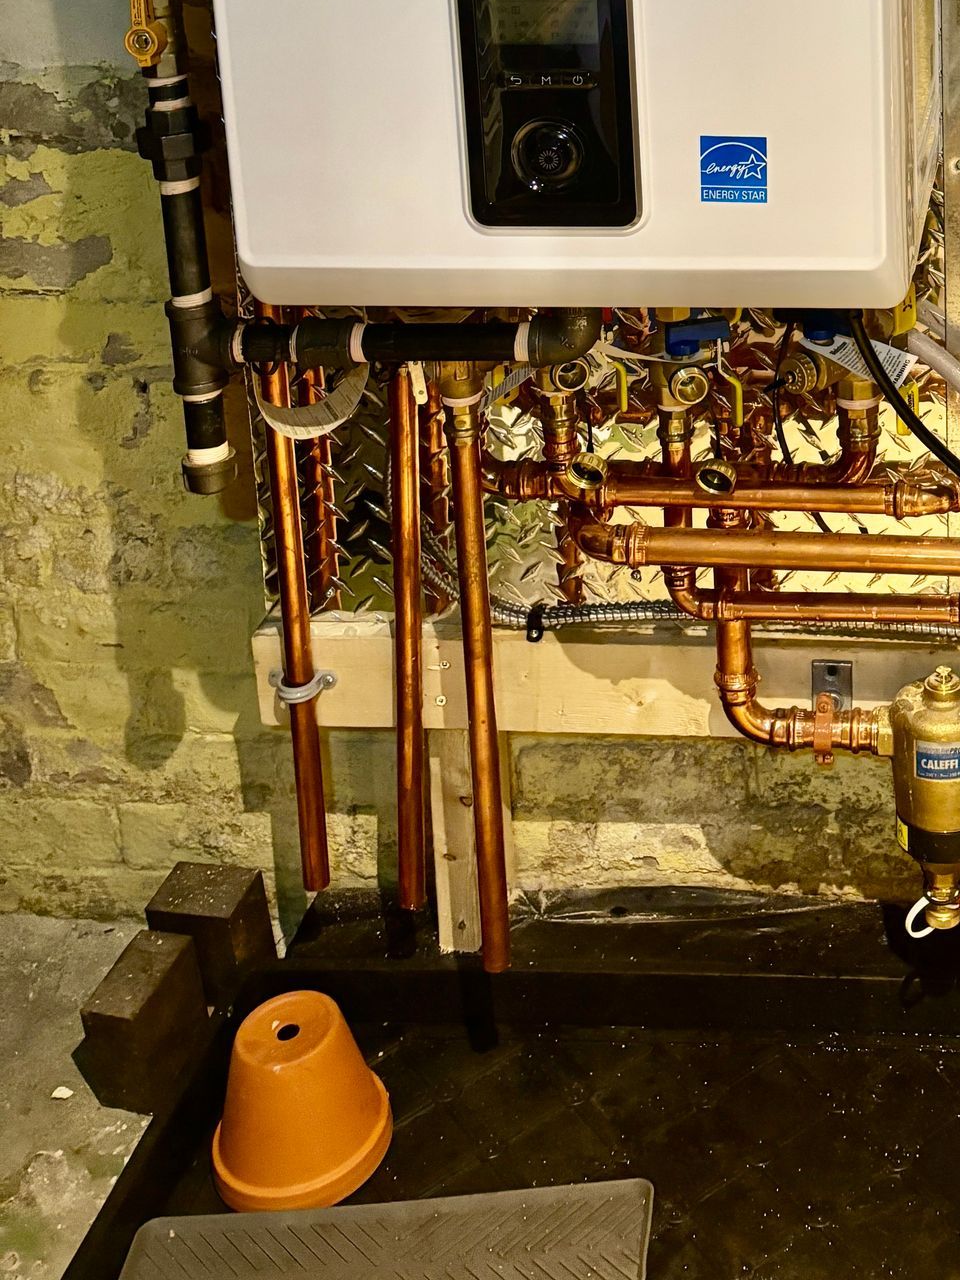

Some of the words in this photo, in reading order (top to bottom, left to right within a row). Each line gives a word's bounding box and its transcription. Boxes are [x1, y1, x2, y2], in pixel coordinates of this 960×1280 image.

[541, 76, 551, 85] M
[703, 190, 740, 199] ENERGY
[742, 190, 765, 200] STAR
[921, 759, 958, 770] CALEFFI
